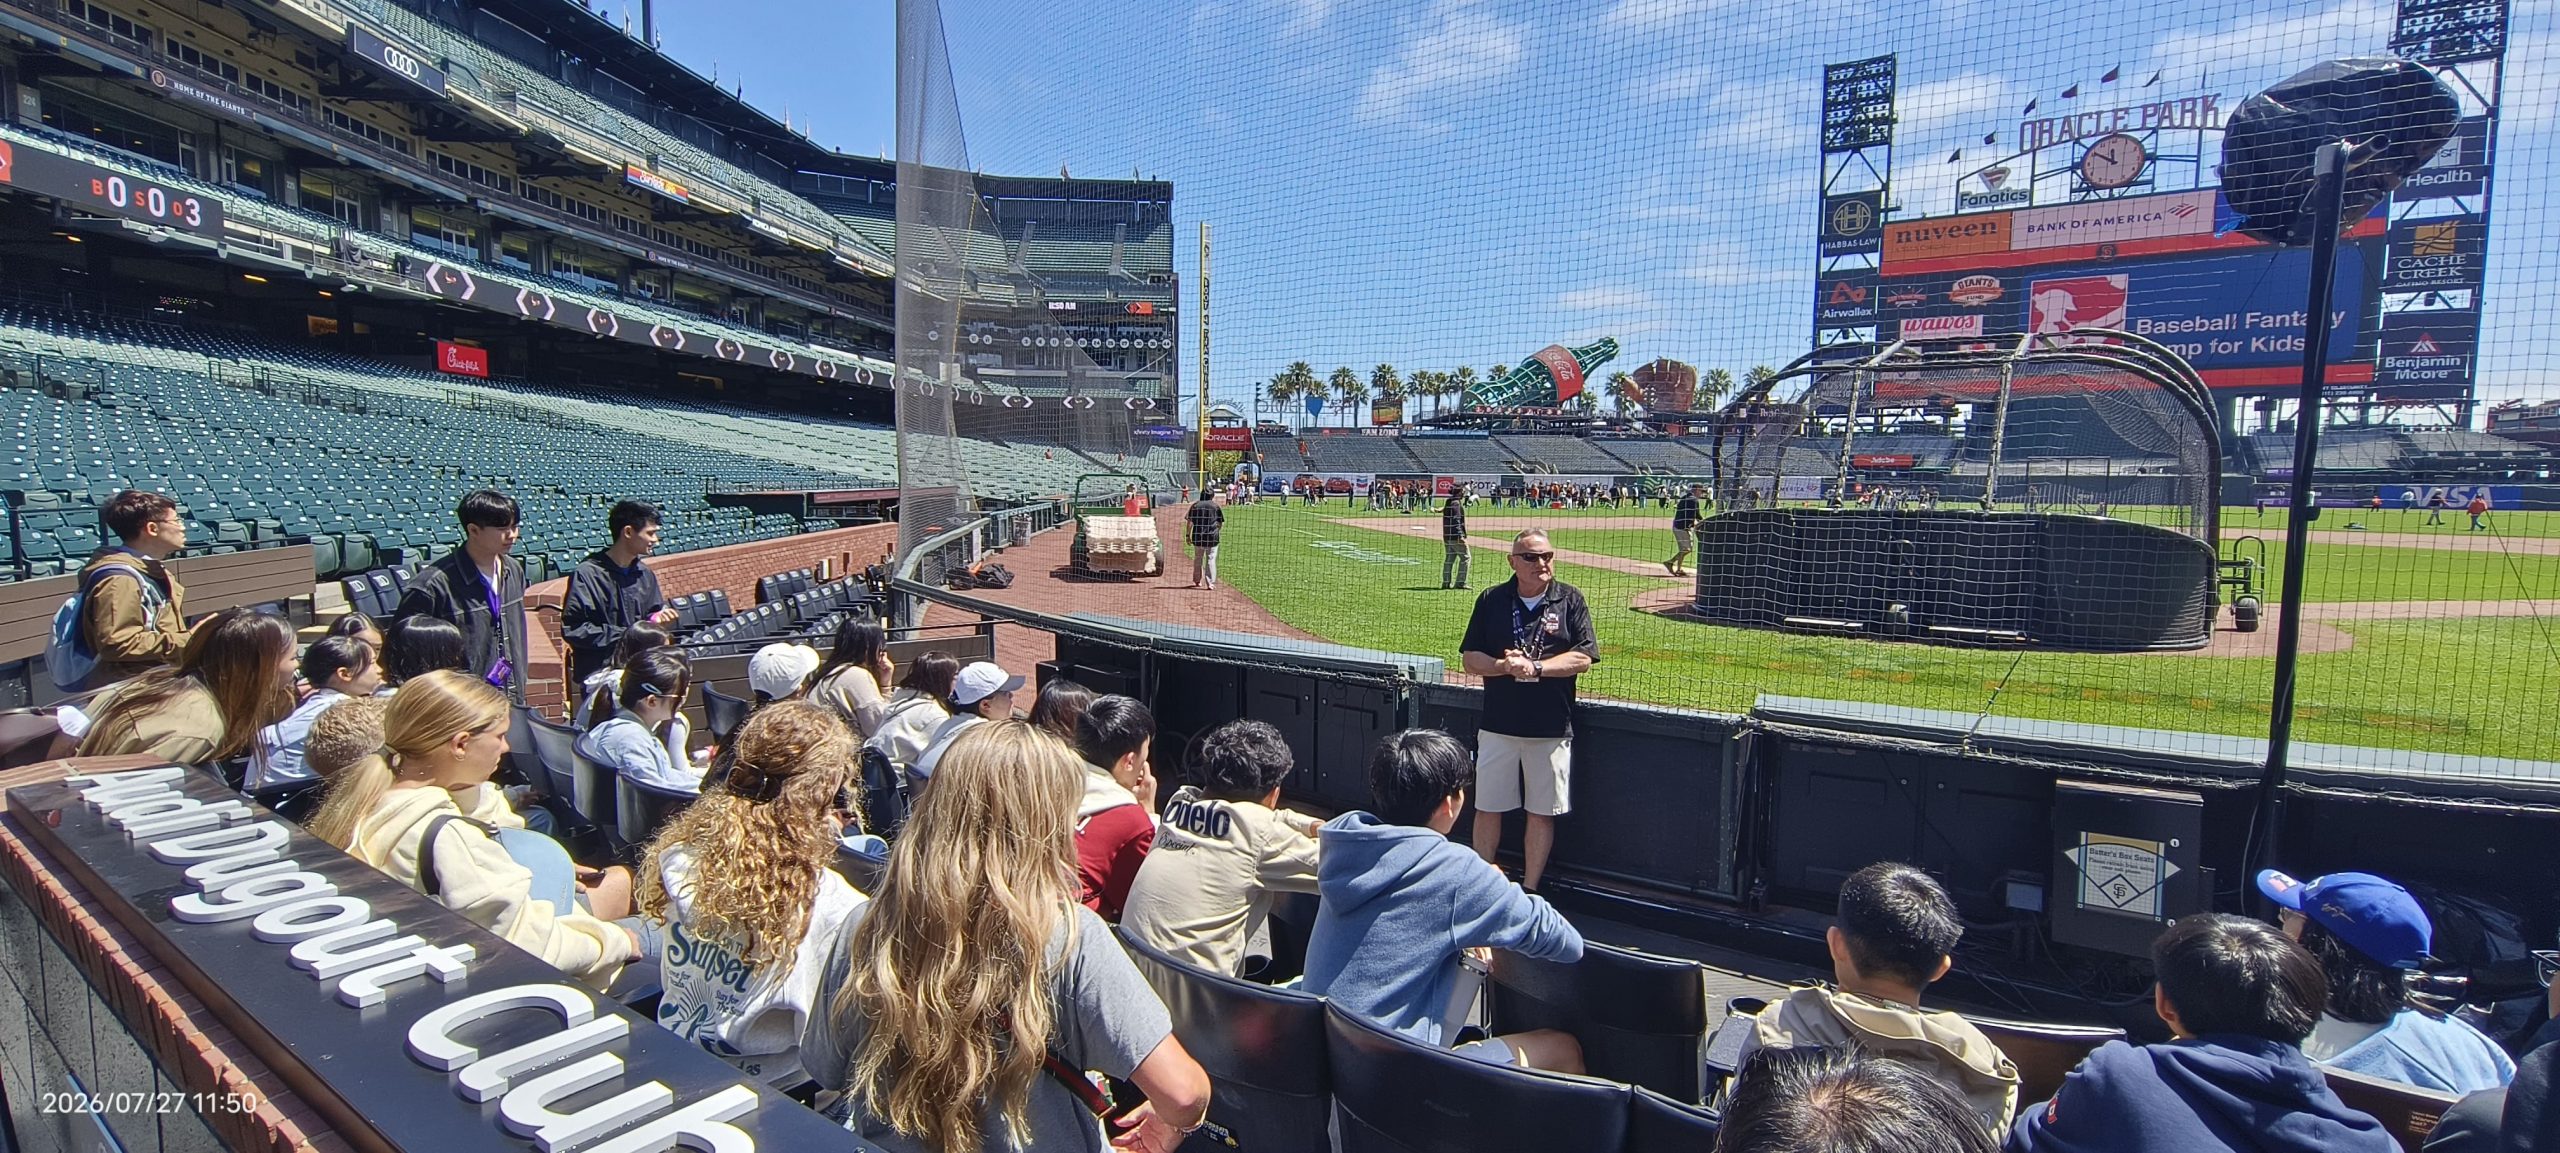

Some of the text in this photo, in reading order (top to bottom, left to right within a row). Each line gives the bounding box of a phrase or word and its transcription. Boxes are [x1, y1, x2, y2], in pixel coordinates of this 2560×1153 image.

[174, 81, 245, 115] HOME OF THE GIANTS
[2020, 93, 2222, 154] ORACLE PARK
[2406, 169, 2472, 187] Health
[91, 179, 104, 196] B
[108, 176, 127, 207] 0
[134, 191, 146, 207] S
[148, 187, 166, 217] 0
[185, 198, 201, 227] 3
[1960, 188, 2029, 208] Fanatics
[1896, 220, 1998, 244] nuveen
[2028, 212, 2163, 233] BANK OF AMERICA
[1824, 237, 1878, 250] HABBAS LAW
[2397, 254, 2467, 269] CACHE
[2398, 266, 2464, 280] CREEK
[1957, 278, 1994, 289] GIANTS
[1823, 307, 1873, 319] Airwallex
[2136, 309, 2346, 336] Baseball Fantay
[2209, 337, 2244, 355] for
[2251, 334, 2306, 353] Kids
[2384, 356, 2461, 370] Benjamin
[2394, 369, 2449, 380] Moore
[1361, 428, 1399, 437] FAN ZONE
[1162, 801, 1231, 838] odelo
[2089, 847, 2155, 863] Batter's Box Seats
[148, 819, 476, 1008] Dugout
[668, 921, 754, 993] Sunset
